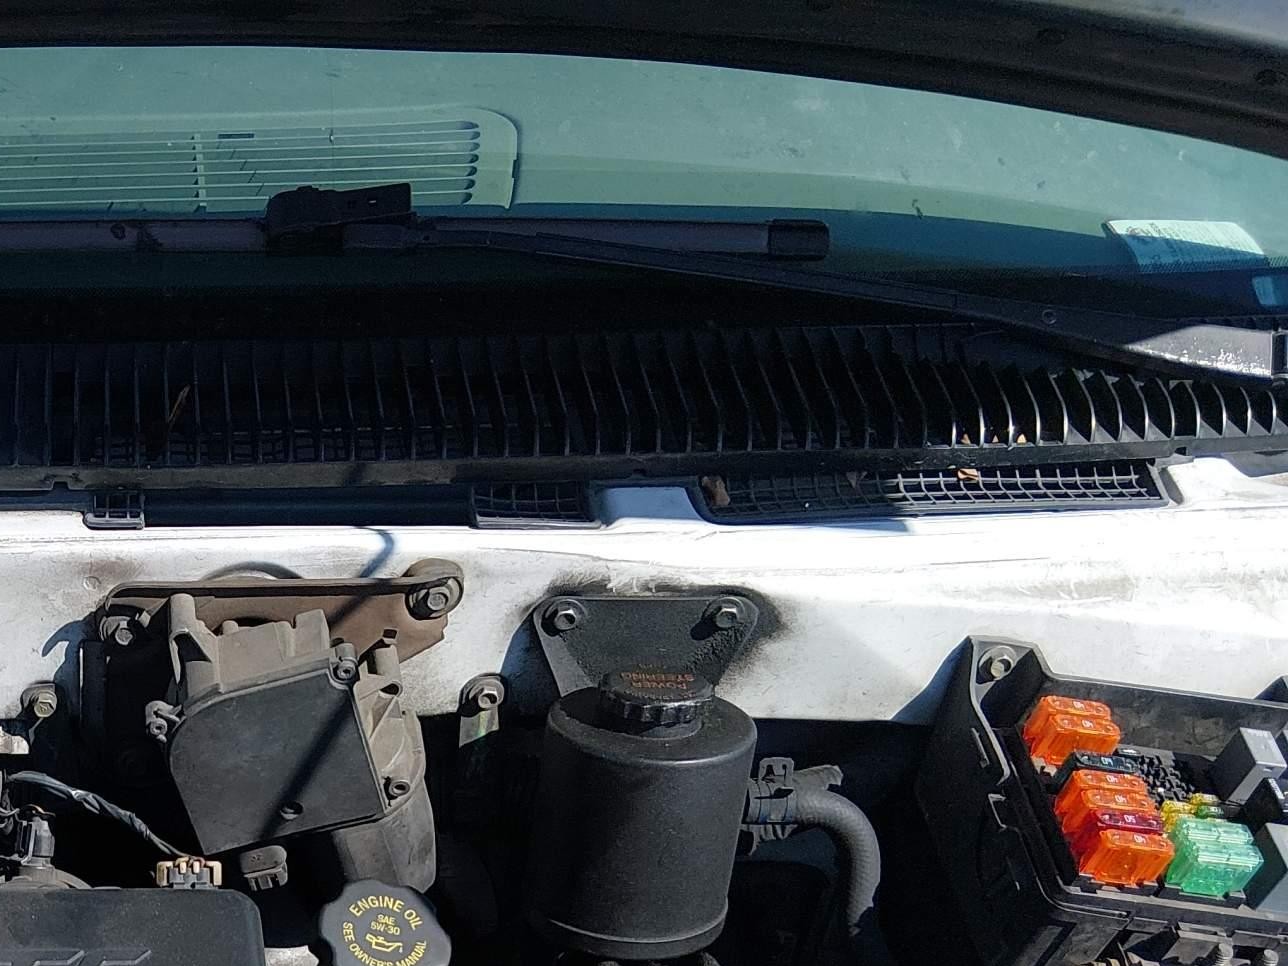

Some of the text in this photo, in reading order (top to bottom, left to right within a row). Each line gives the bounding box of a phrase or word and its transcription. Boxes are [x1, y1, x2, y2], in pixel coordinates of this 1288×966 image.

[631, 681, 687, 690] POWER
[348, 895, 424, 931] ENGINE OIL
[376, 914, 396, 926] SAE
[342, 921, 356, 943] SEE
[370, 921, 401, 936] 5W-30
